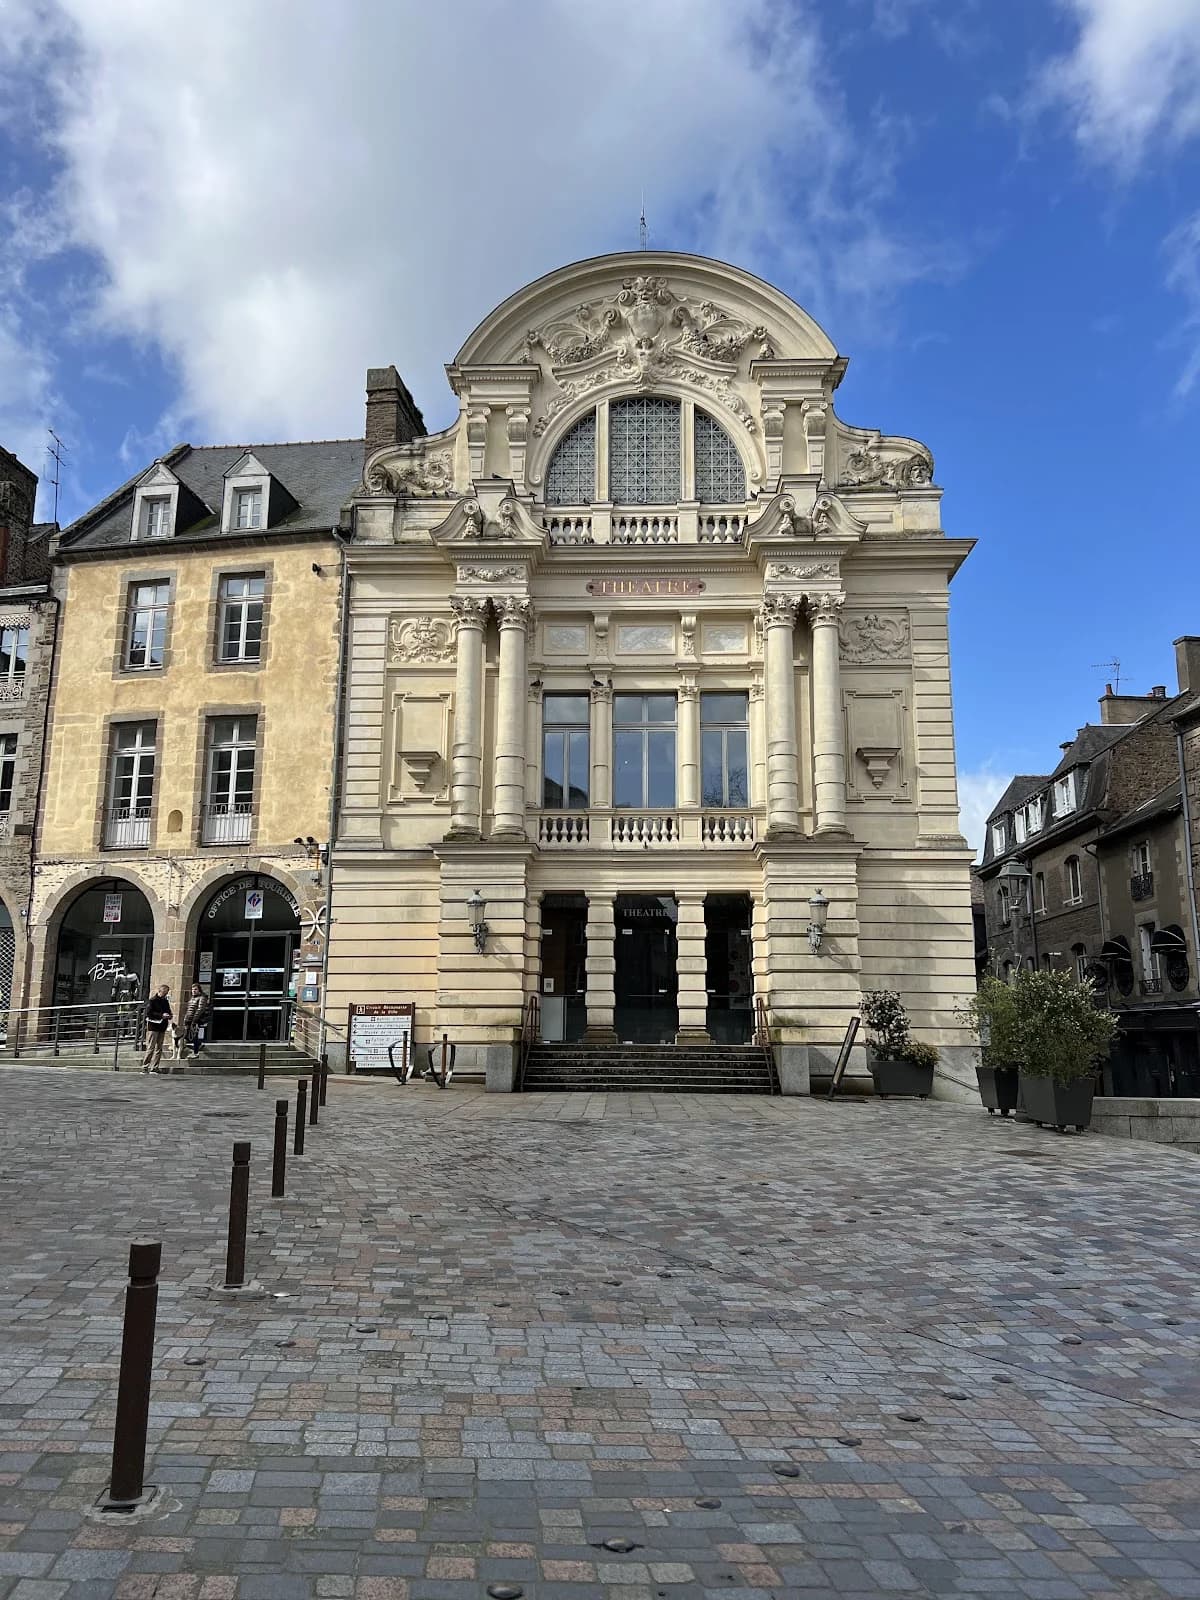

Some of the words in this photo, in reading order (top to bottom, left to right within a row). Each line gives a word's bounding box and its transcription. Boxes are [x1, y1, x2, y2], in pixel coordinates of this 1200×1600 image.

[208, 886, 237, 919] OFFICE
[239, 881, 253, 890] DE
[259, 880, 301, 917] TOURISME
[623, 908, 670, 917] THEATRE
